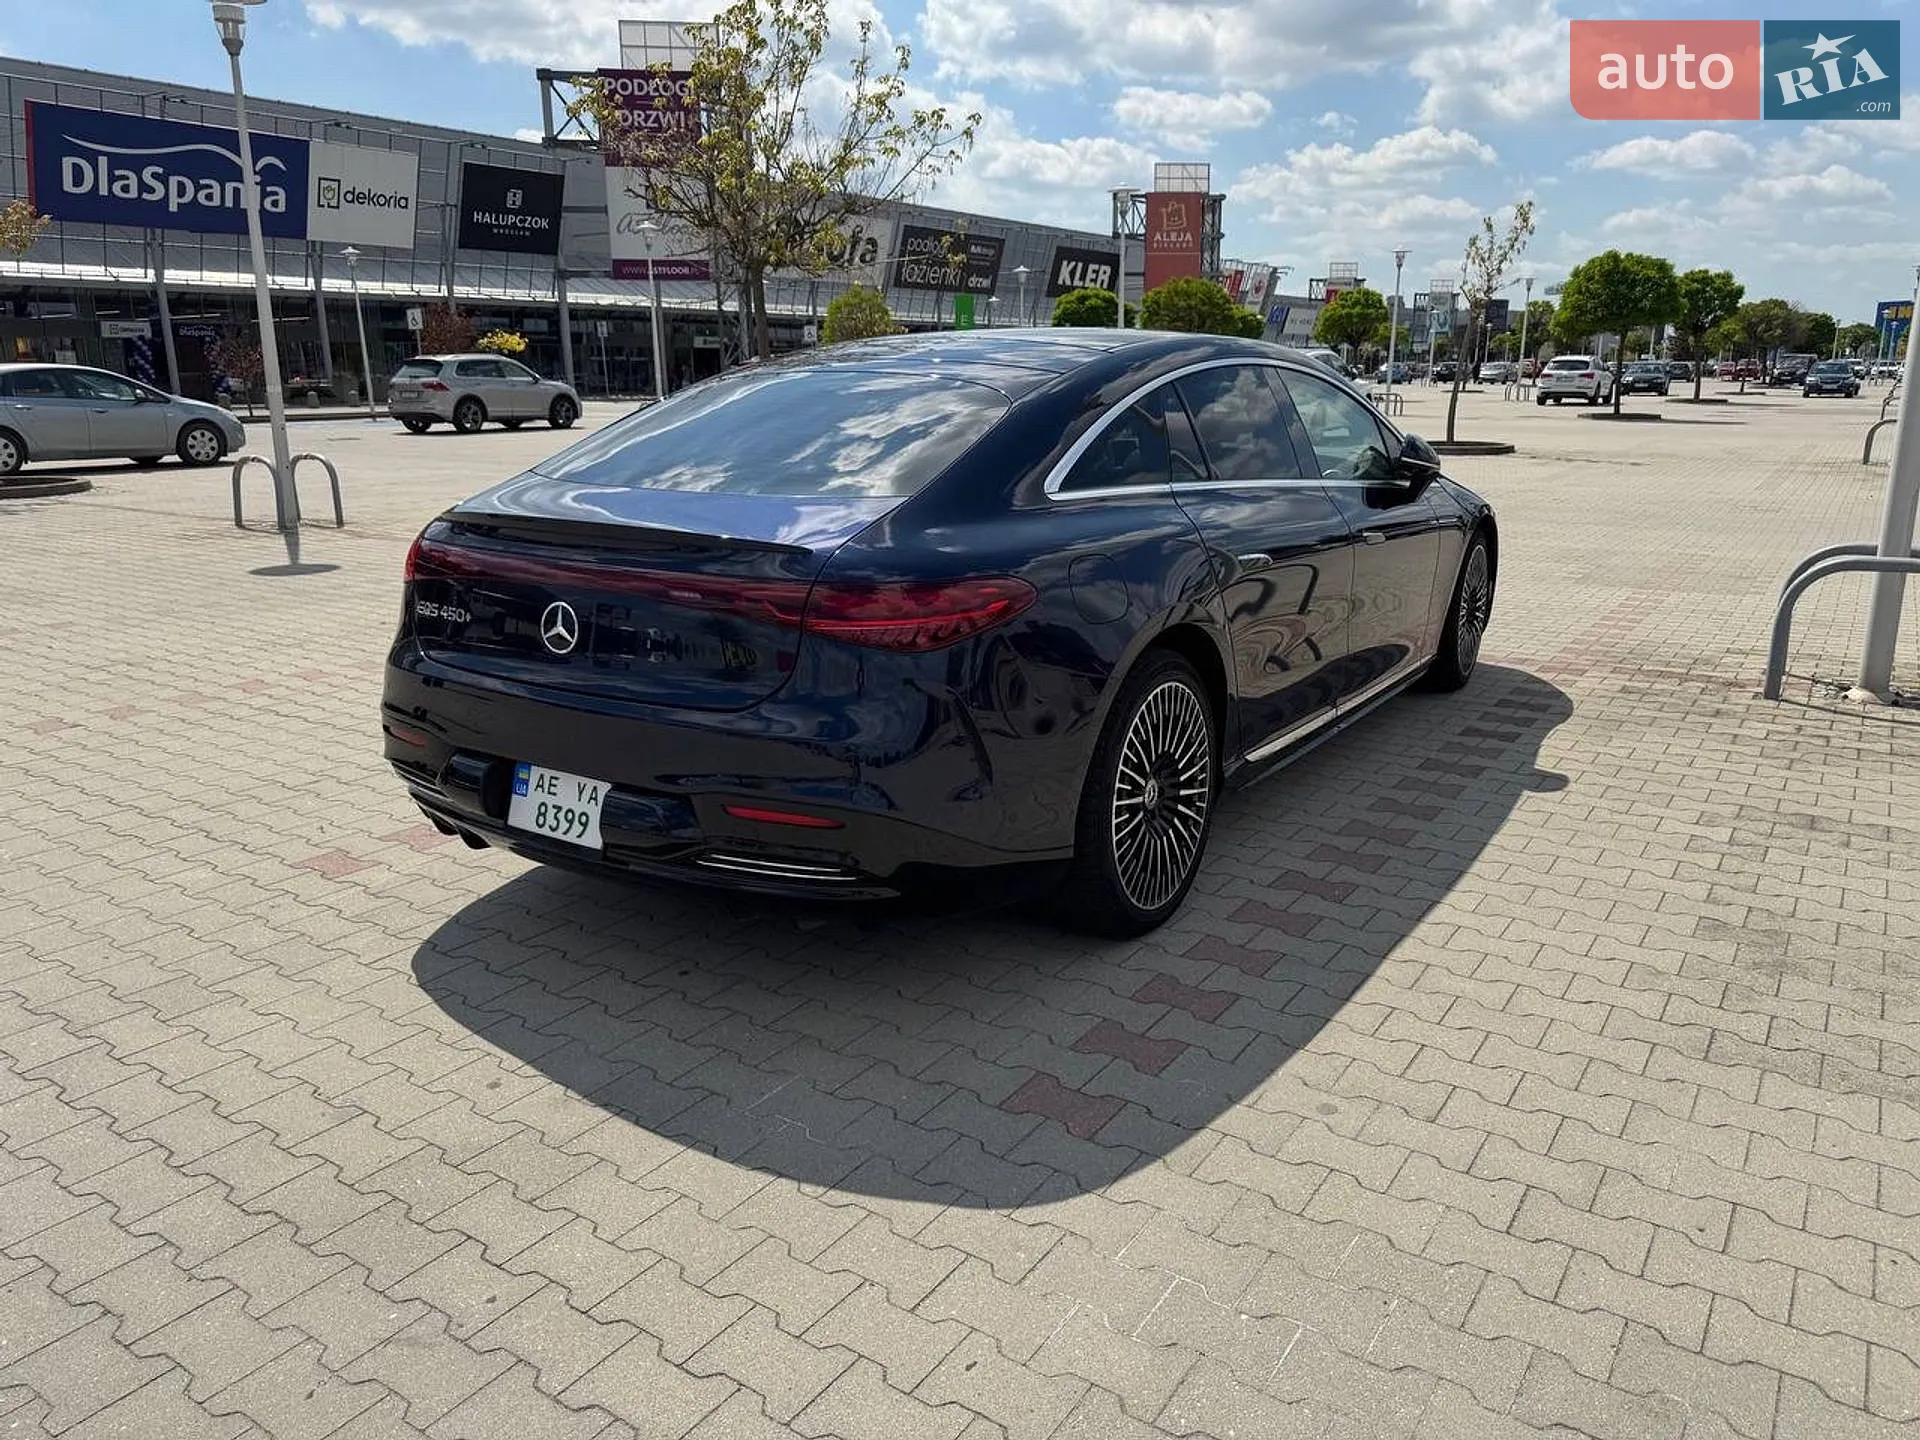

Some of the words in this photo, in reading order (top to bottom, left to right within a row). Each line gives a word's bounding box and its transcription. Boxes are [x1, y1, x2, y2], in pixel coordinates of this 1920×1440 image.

[61, 156, 287, 214] DlaSpania
[343, 187, 410, 210] dekoria
[1153, 231, 1193, 241] ALEJA
[1056, 260, 1113, 289] KLER
[534, 773, 558, 797] AE
[577, 781, 599, 807] YA
[535, 802, 590, 839] 8399
